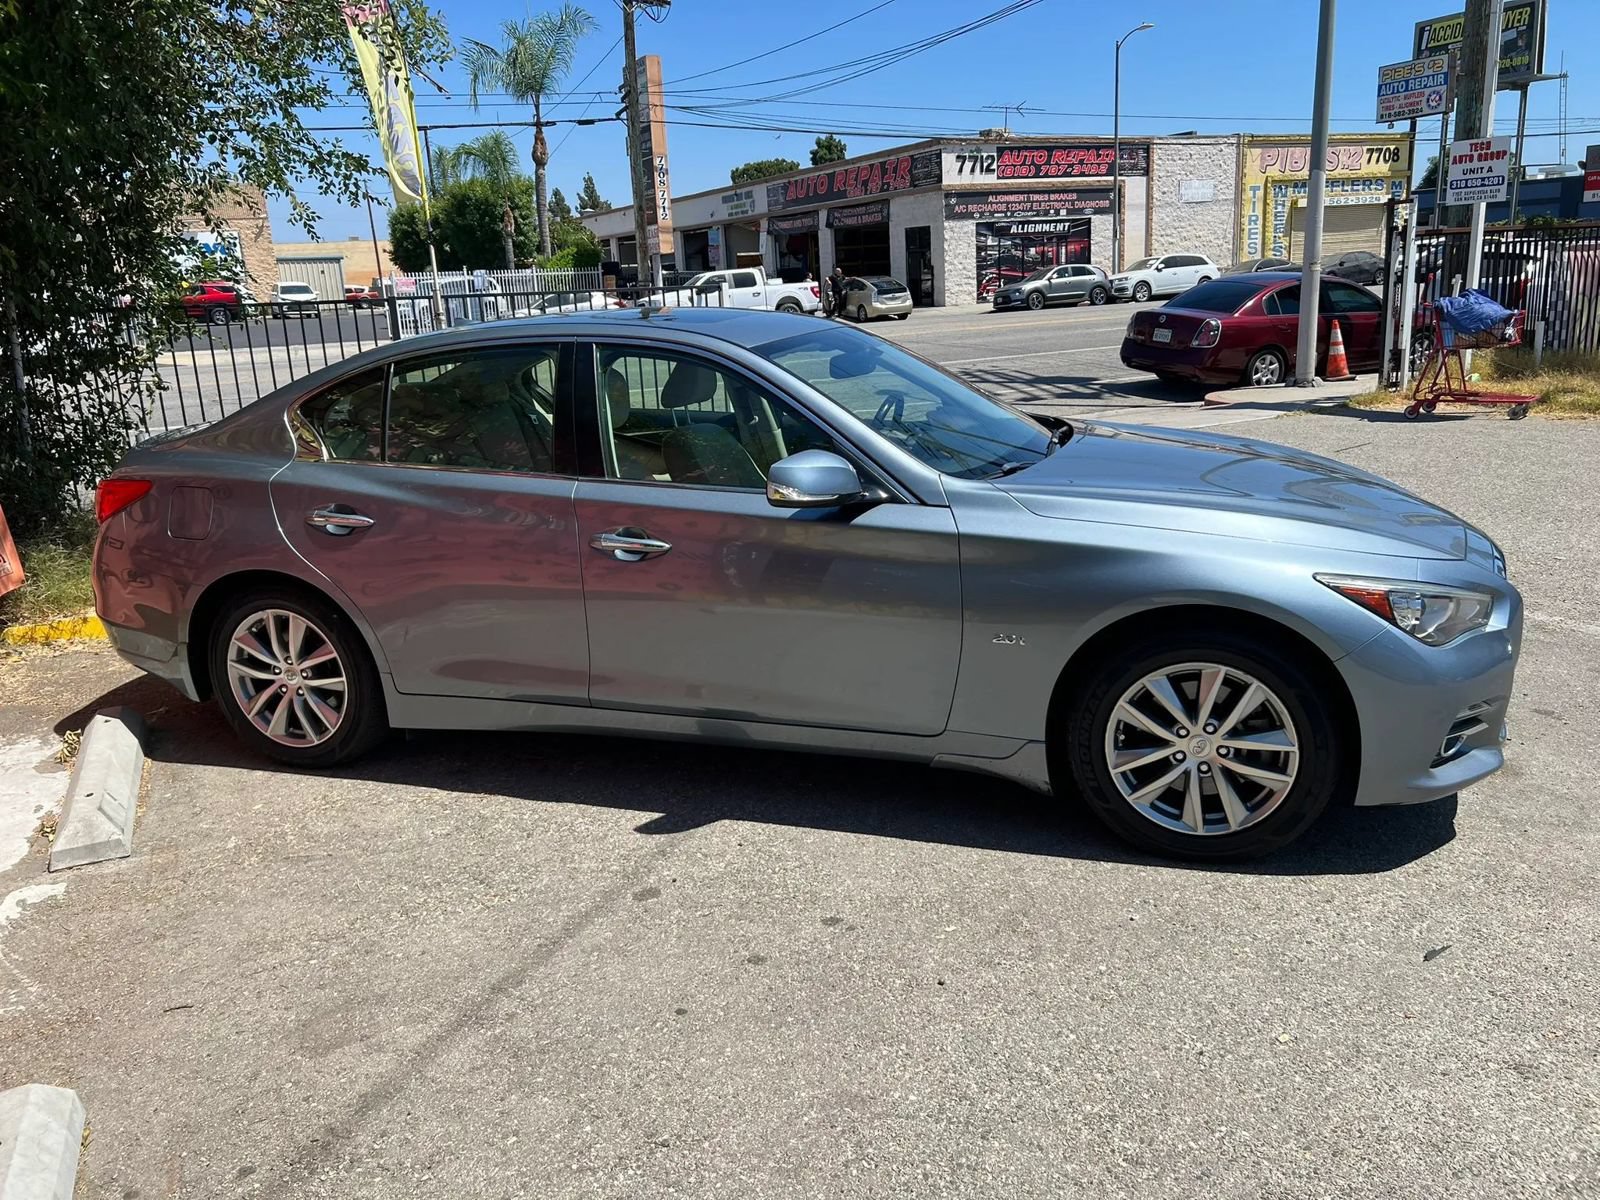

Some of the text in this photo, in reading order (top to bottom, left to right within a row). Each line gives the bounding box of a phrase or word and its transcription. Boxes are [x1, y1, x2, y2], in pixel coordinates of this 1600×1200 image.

[1380, 74, 1444, 96] AUTO REPAIR
[1469, 141, 1491, 152] TECH
[999, 149, 1048, 165] AUTO
[1366, 147, 1400, 165] 7708
[1451, 150, 1507, 165] AUTO GROUP
[955, 154, 996, 175] 7712
[998, 164, 1109, 176] (818) 787-3492
[1462, 167, 1484, 175] UNIT
[786, 174, 828, 200] AUTO
[833, 156, 912, 192] REPAIR
[1451, 177, 1503, 188] 310 650-4201
[987, 192, 1077, 203] ALIGNMENT TIRES BRAKES
[954, 199, 1110, 213] A/C RECHARGE 1234YF ELECTRICAL DIAGNOSIS
[1247, 185, 1261, 255] TIRES
[1010, 222, 1070, 234] ALIGNMENT
